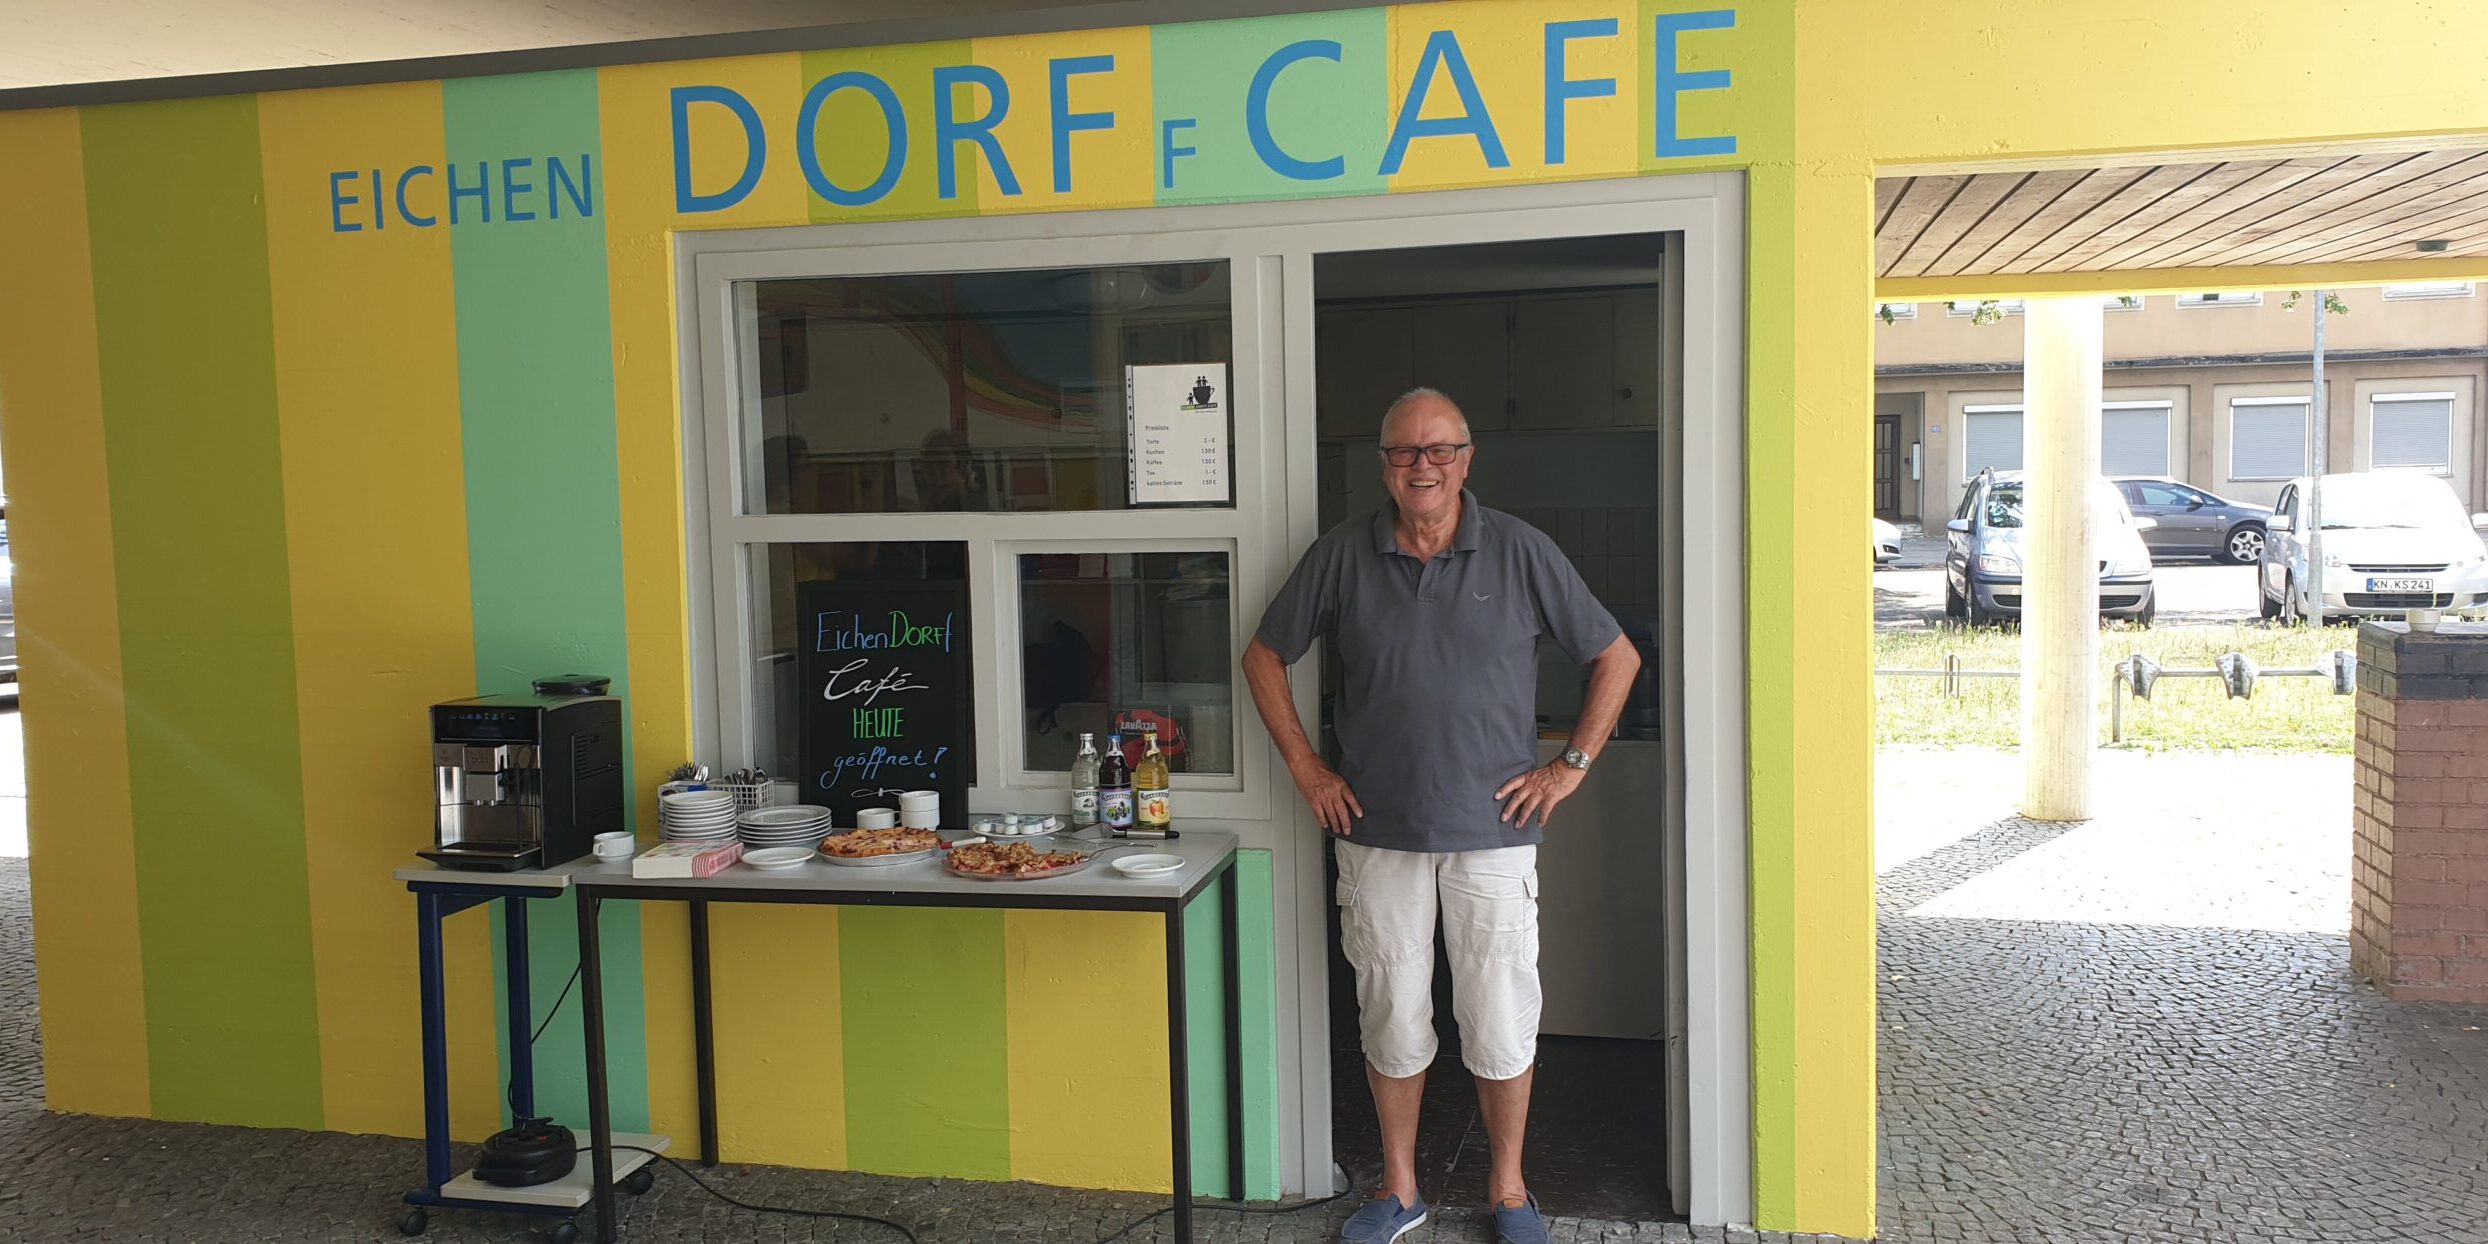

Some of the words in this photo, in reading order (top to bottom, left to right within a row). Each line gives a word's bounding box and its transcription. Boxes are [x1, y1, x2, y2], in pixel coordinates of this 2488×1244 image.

[330, 153, 594, 233] EICHEN
[669, 56, 1115, 214] DORF
[1162, 118, 1197, 189] F
[1246, 9, 1737, 181] CAFE
[2373, 580, 2388, 590] KN
[2394, 580, 2409, 590] KS
[2411, 580, 2431, 590] 241
[823, 658, 929, 707] Café
[853, 707, 905, 739] HEUTE
